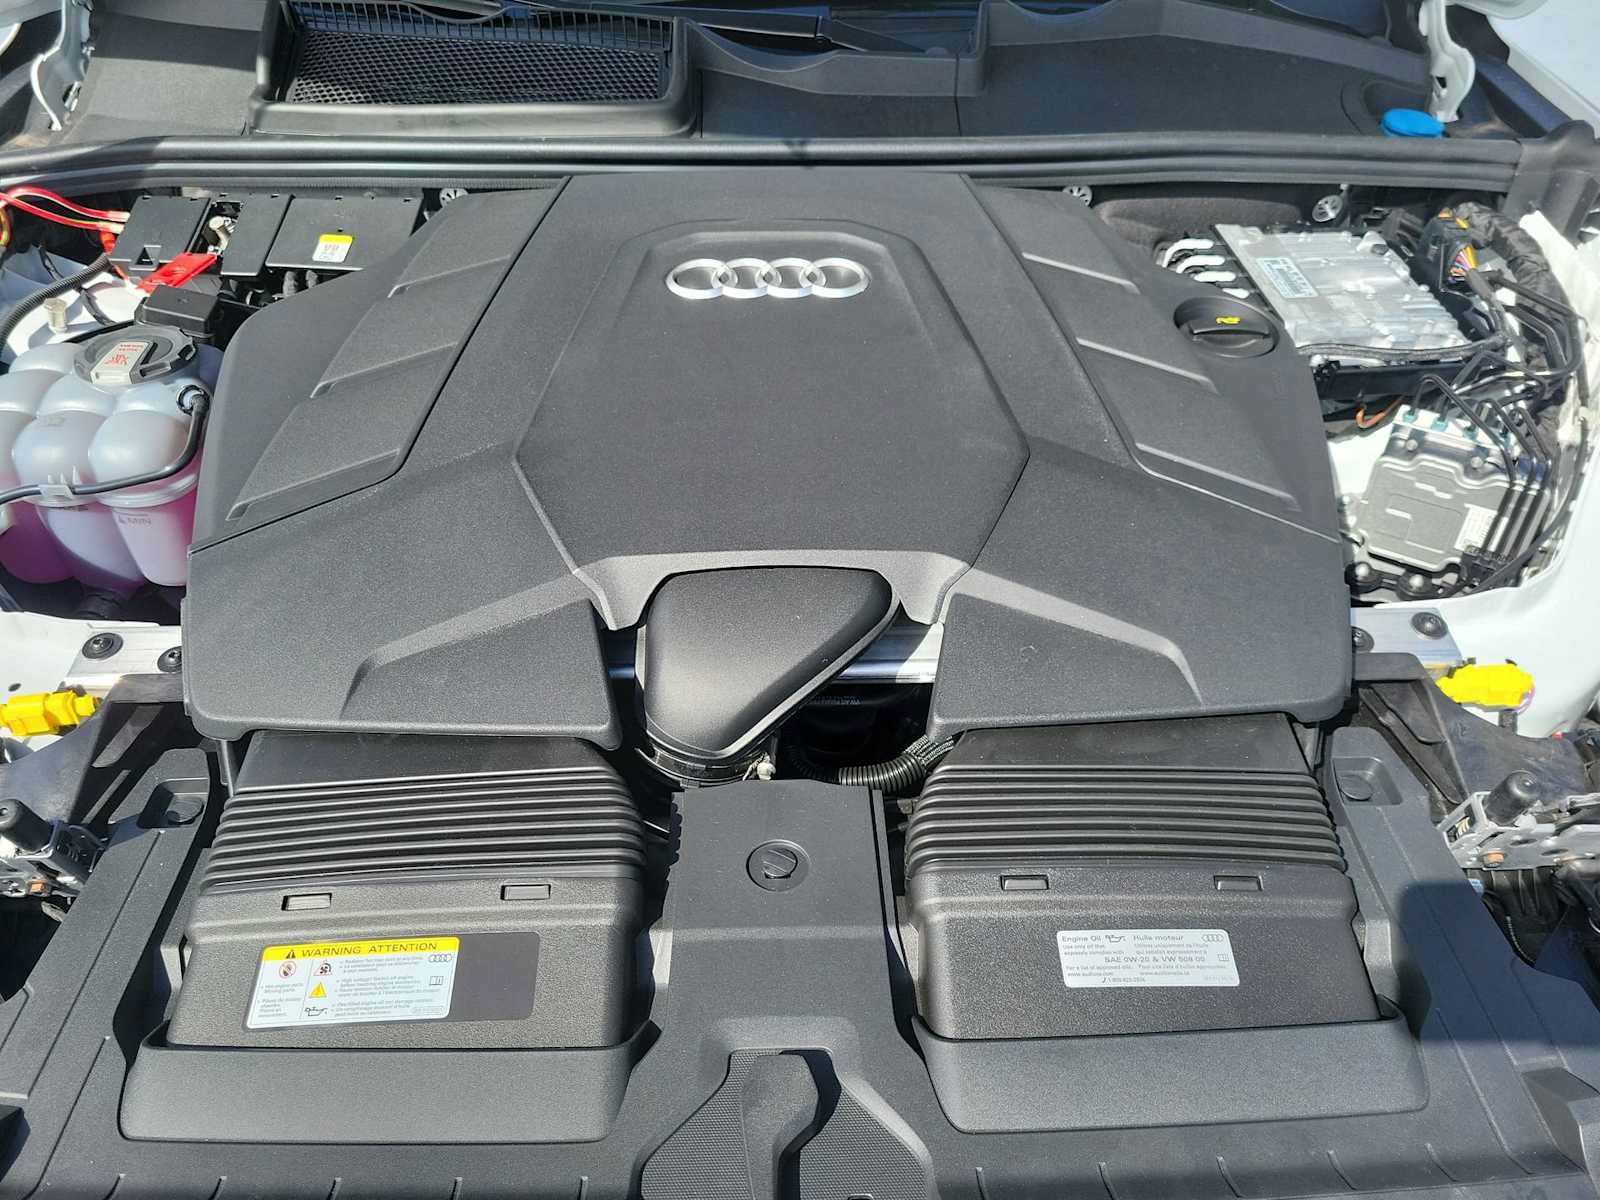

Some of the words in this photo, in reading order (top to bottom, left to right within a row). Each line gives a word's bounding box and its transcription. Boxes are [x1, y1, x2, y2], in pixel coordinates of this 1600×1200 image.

[1062, 935, 1088, 943] Engine
[301, 946, 361, 957] WARNING
[368, 943, 438, 953] ATTENTION
